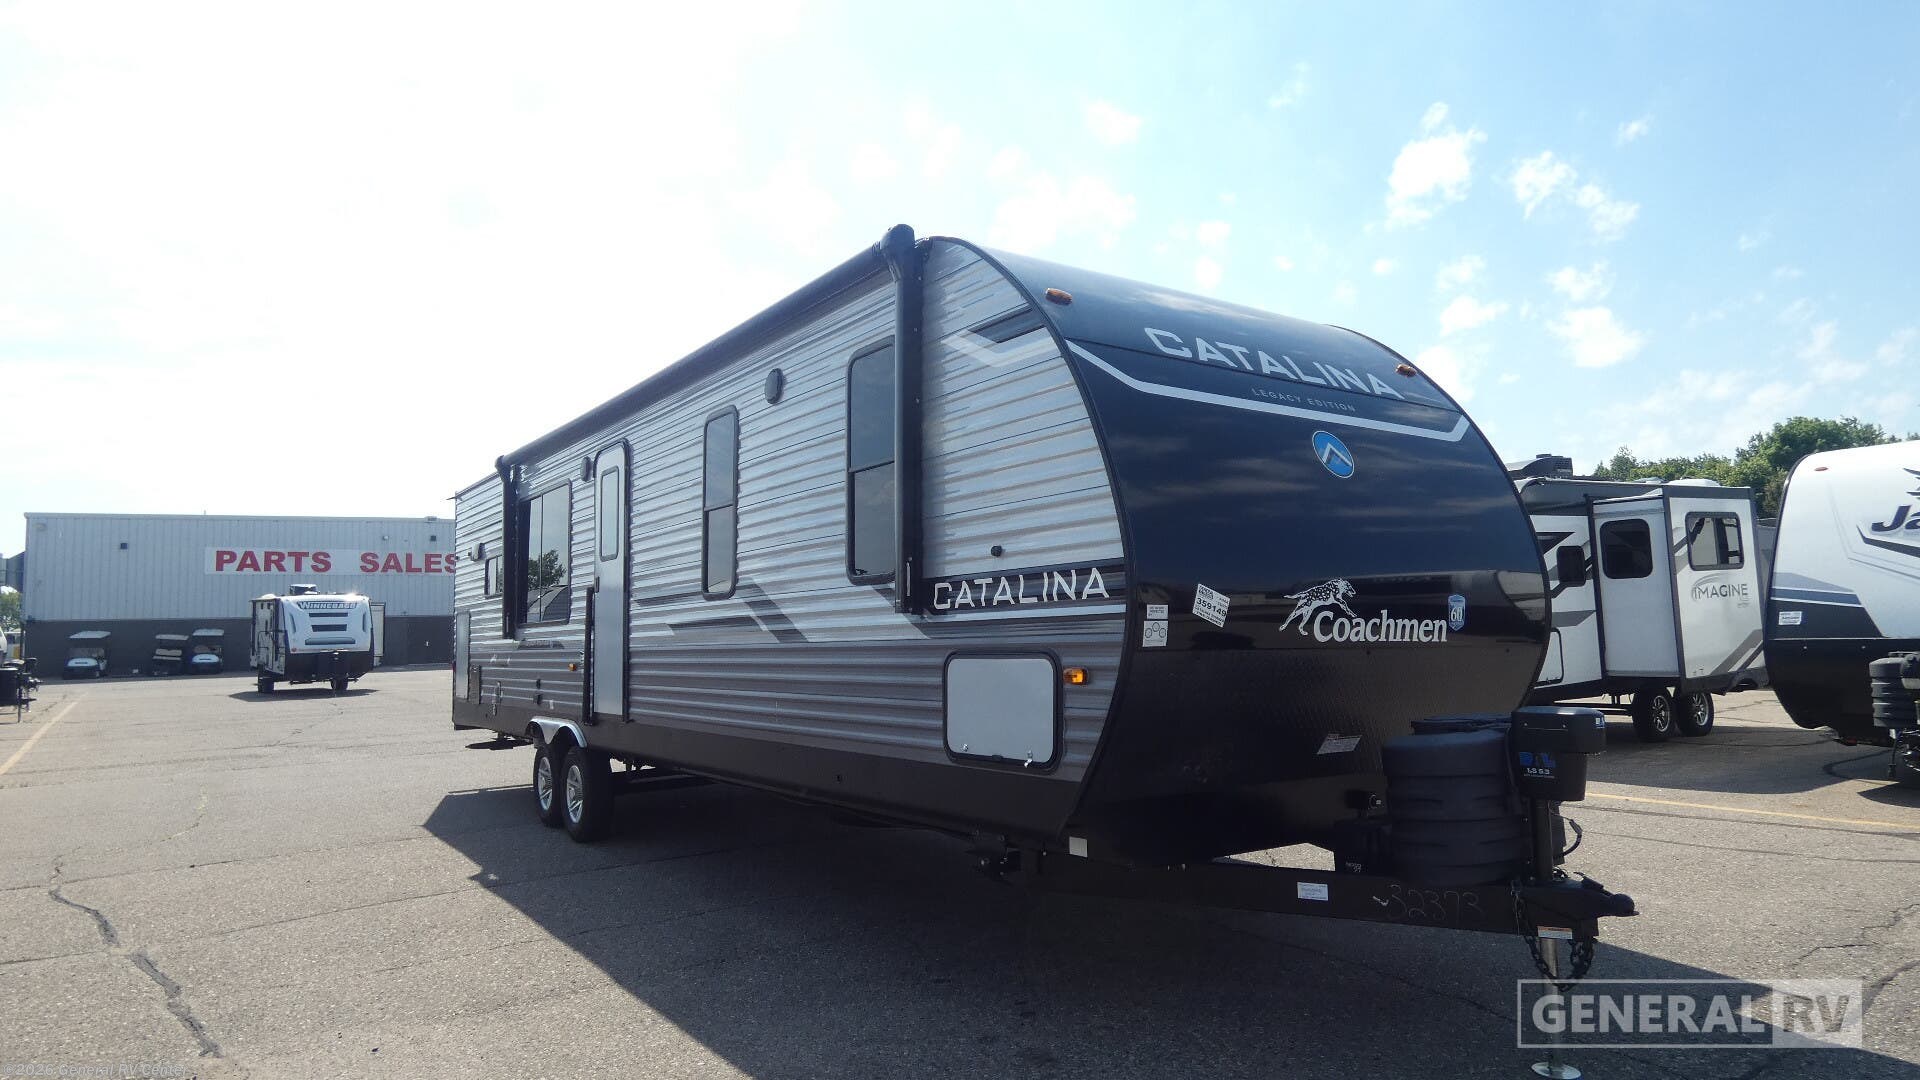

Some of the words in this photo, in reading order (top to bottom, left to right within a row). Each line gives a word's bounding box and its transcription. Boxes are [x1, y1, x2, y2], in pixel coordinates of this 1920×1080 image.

[1144, 327, 1405, 400] CATALINA
[1251, 388, 1301, 405] LEGACY
[1307, 398, 1356, 413] EDITION
[215, 550, 332, 573] PARTS
[933, 567, 1110, 610] CATALINA
[1692, 583, 1749, 600] IMAGINE
[1313, 609, 1447, 643] Coachmen
